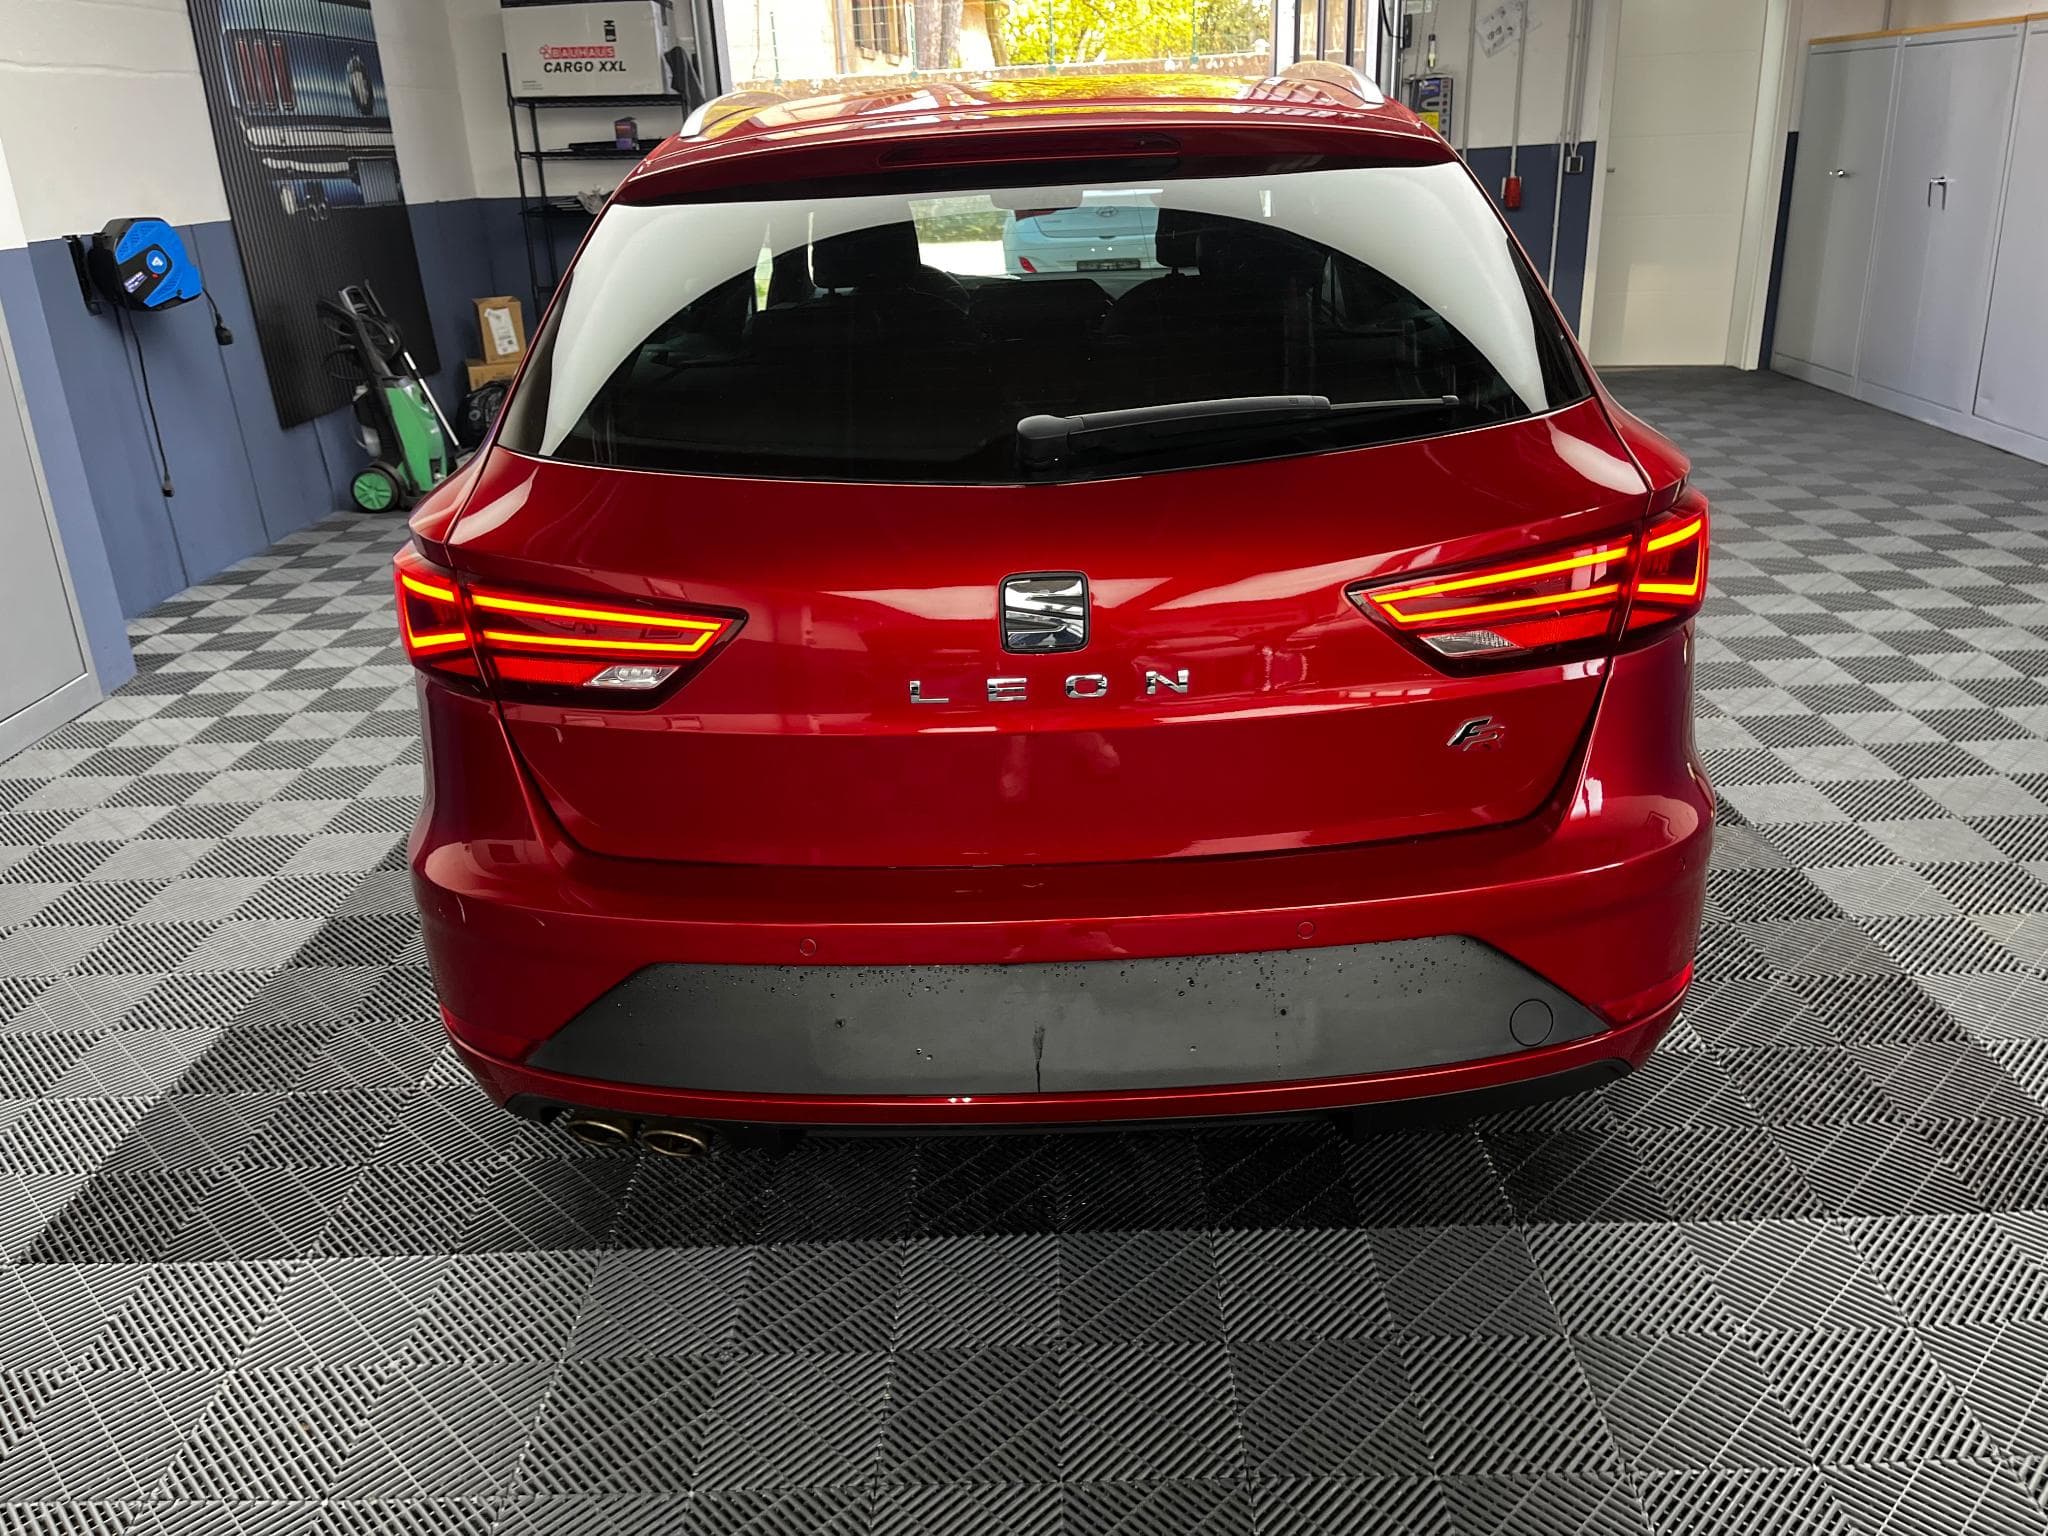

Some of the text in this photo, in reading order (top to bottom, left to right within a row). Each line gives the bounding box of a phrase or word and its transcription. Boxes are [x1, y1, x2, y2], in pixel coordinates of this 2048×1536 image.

[551, 46, 615, 58] BAUHAUS
[543, 60, 627, 73] CARGO XXL
[909, 669, 1190, 704] LEON
